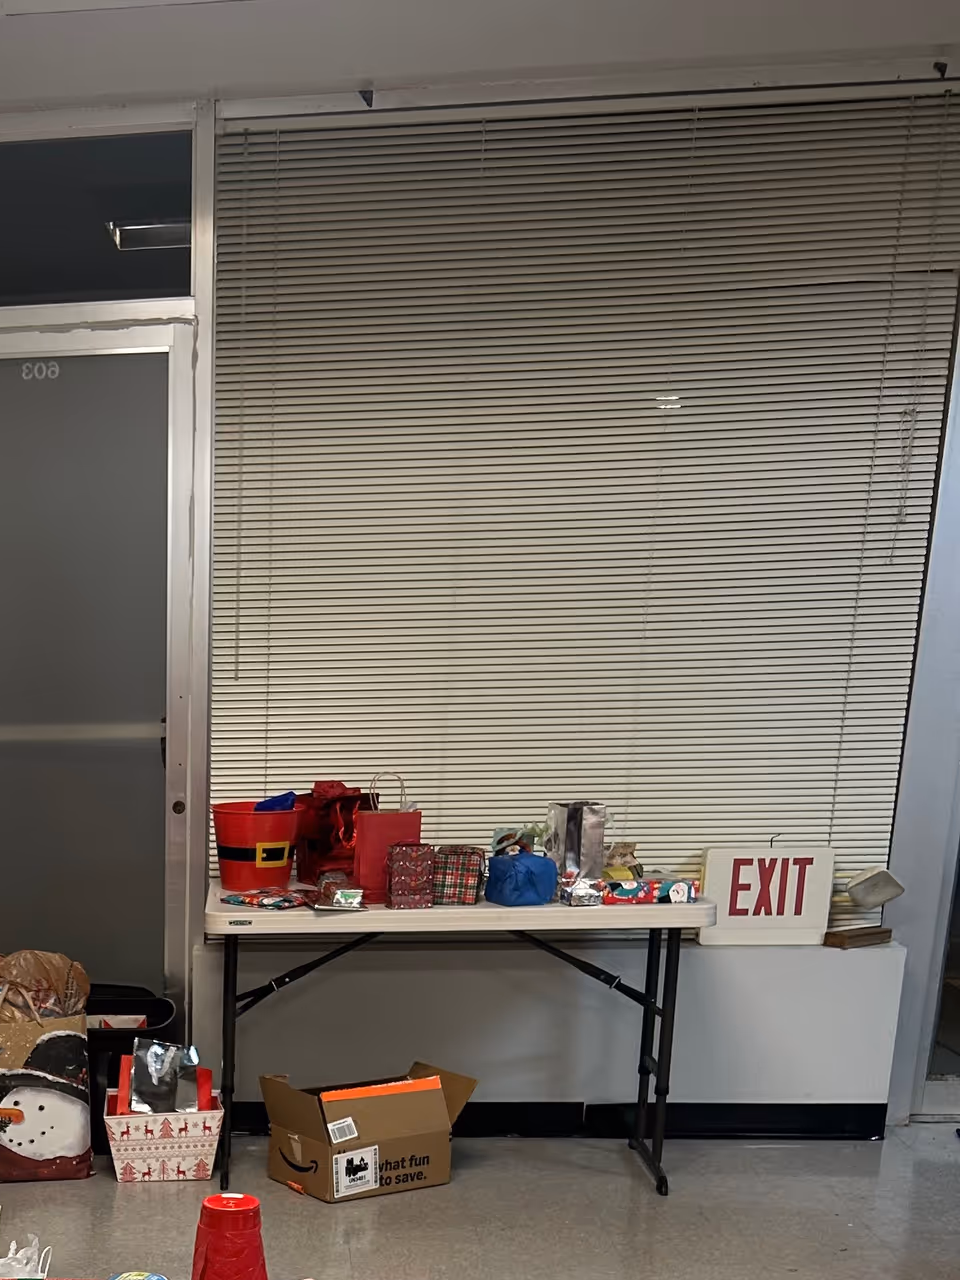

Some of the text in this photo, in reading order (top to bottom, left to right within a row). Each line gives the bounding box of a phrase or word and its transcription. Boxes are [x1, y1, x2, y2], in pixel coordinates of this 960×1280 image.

[728, 857, 814, 916] EXIT
[408, 1154, 430, 1168] fun
[379, 1175, 392, 1187] to
[394, 1170, 427, 1185] save.
